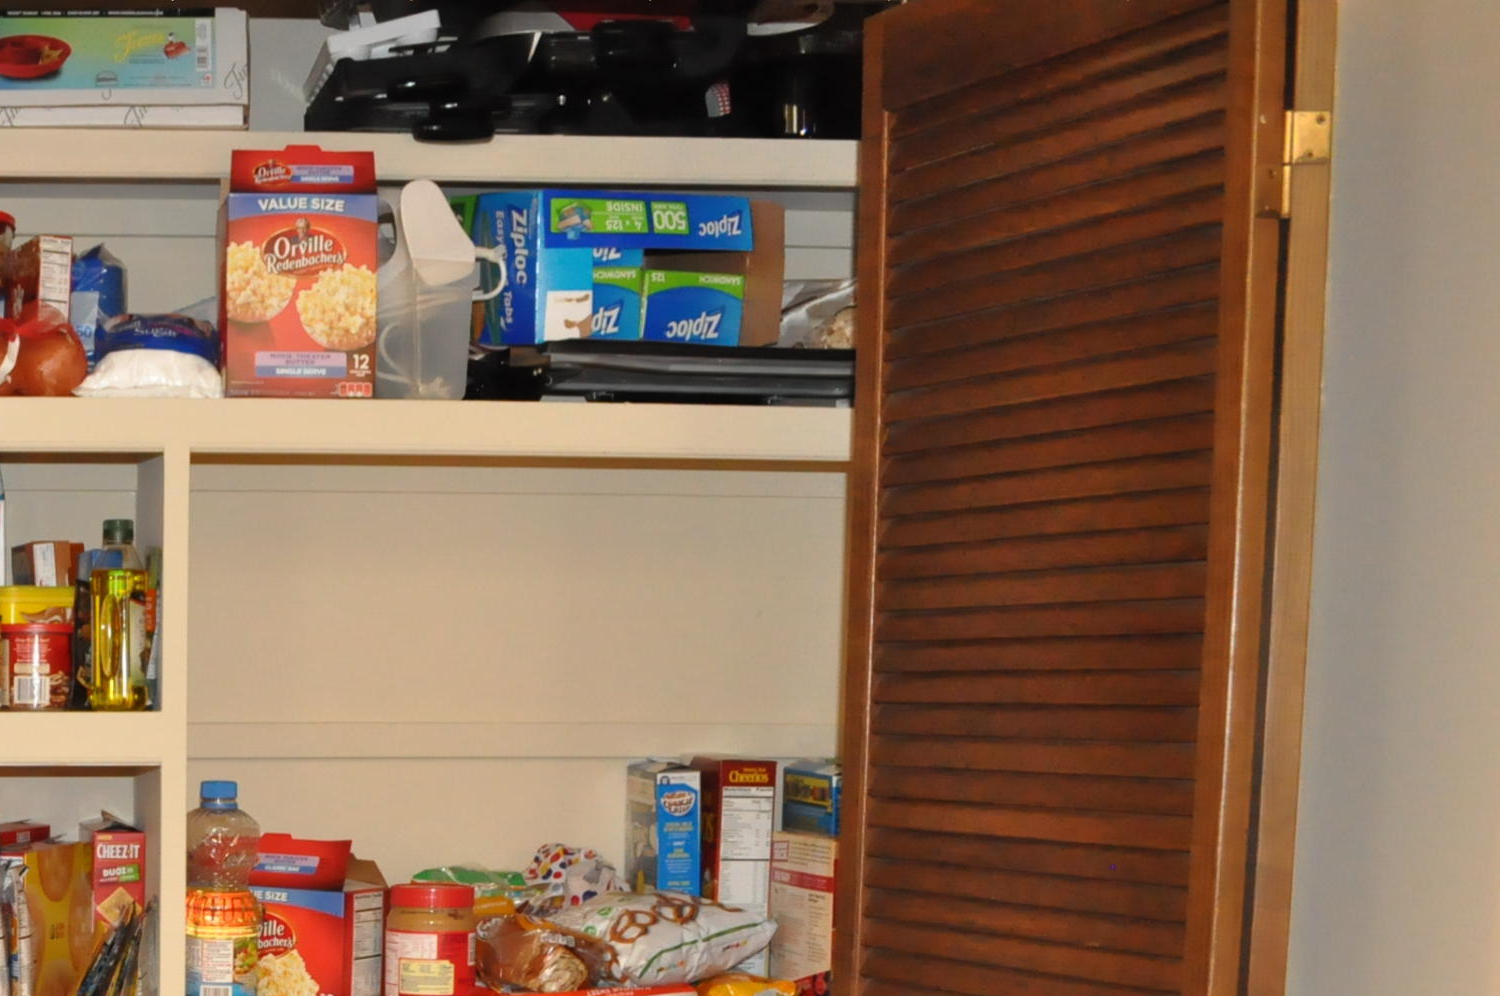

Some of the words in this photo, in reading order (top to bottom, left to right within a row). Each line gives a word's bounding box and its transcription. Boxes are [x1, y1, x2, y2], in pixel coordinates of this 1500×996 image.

[258, 197, 307, 211] VALUE
[311, 198, 345, 212] SIZE
[606, 201, 643, 213] INSIDE
[653, 210, 686, 231] 500
[699, 214, 742, 238] Ziploc
[274, 234, 333, 260] Orville
[511, 209, 528, 285] Ziploc
[651, 271, 665, 283] 125
[699, 273, 742, 285] SANDWICH
[666, 311, 722, 341] Ziploc
[352, 353, 370, 370] 12
[264, 890, 288, 902] SIZE
